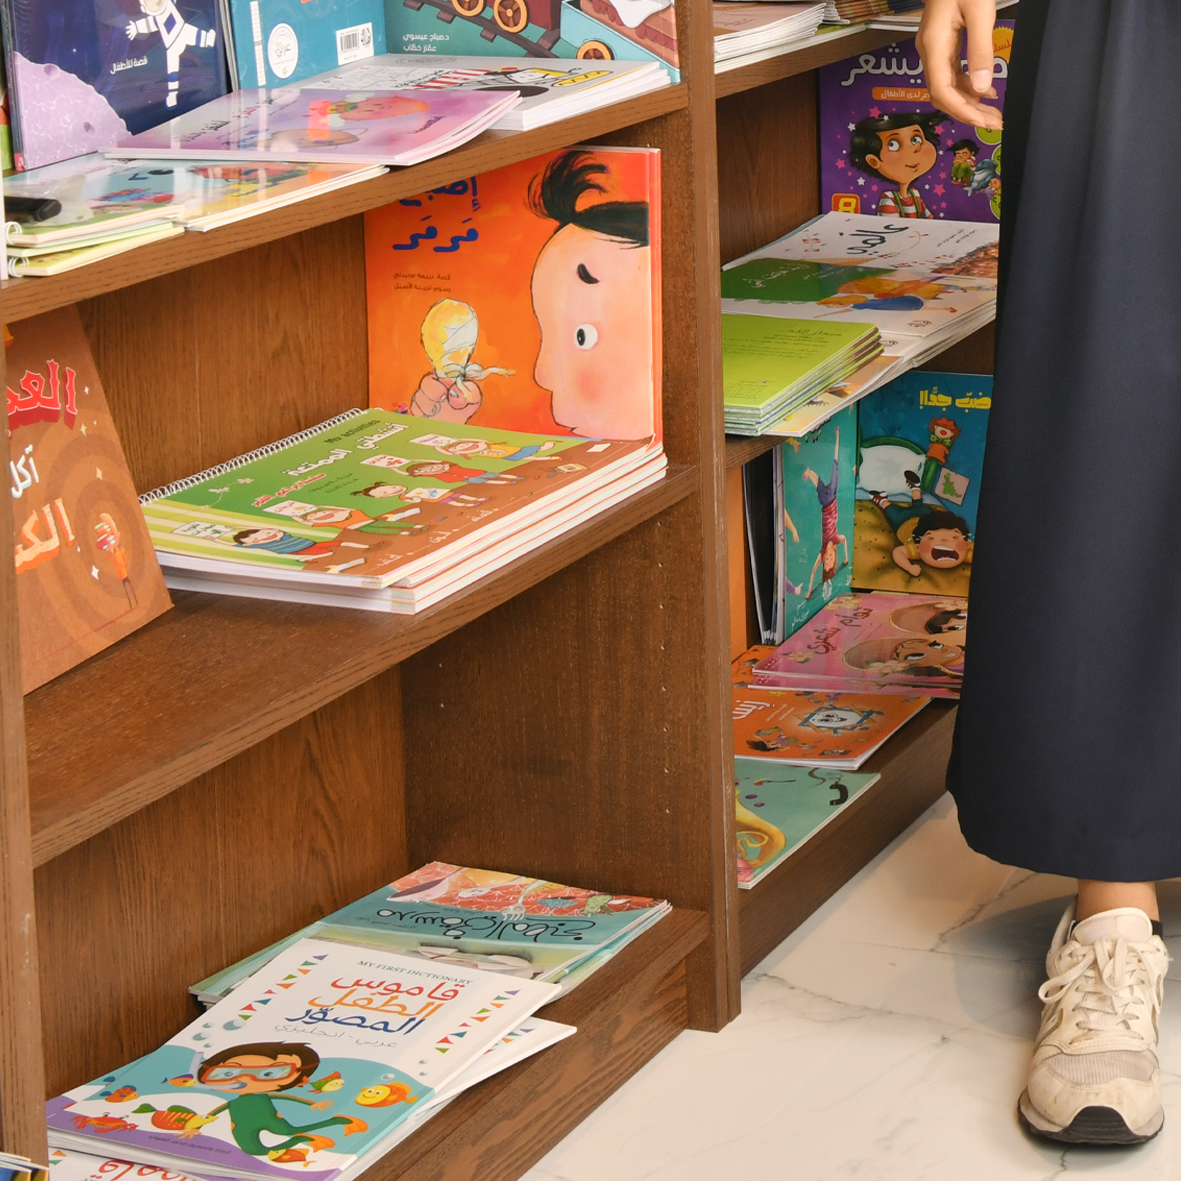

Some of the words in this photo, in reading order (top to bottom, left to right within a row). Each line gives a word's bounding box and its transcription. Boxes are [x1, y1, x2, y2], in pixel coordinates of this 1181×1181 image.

[357, 959, 375, 968] MY
[375, 963, 407, 975] FIRST
[406, 968, 474, 986] DICTIONARY
[330, 977, 465, 1002] قاموس
[307, 988, 446, 1020] الطفل
[355, 1035, 398, 1048] عربي
